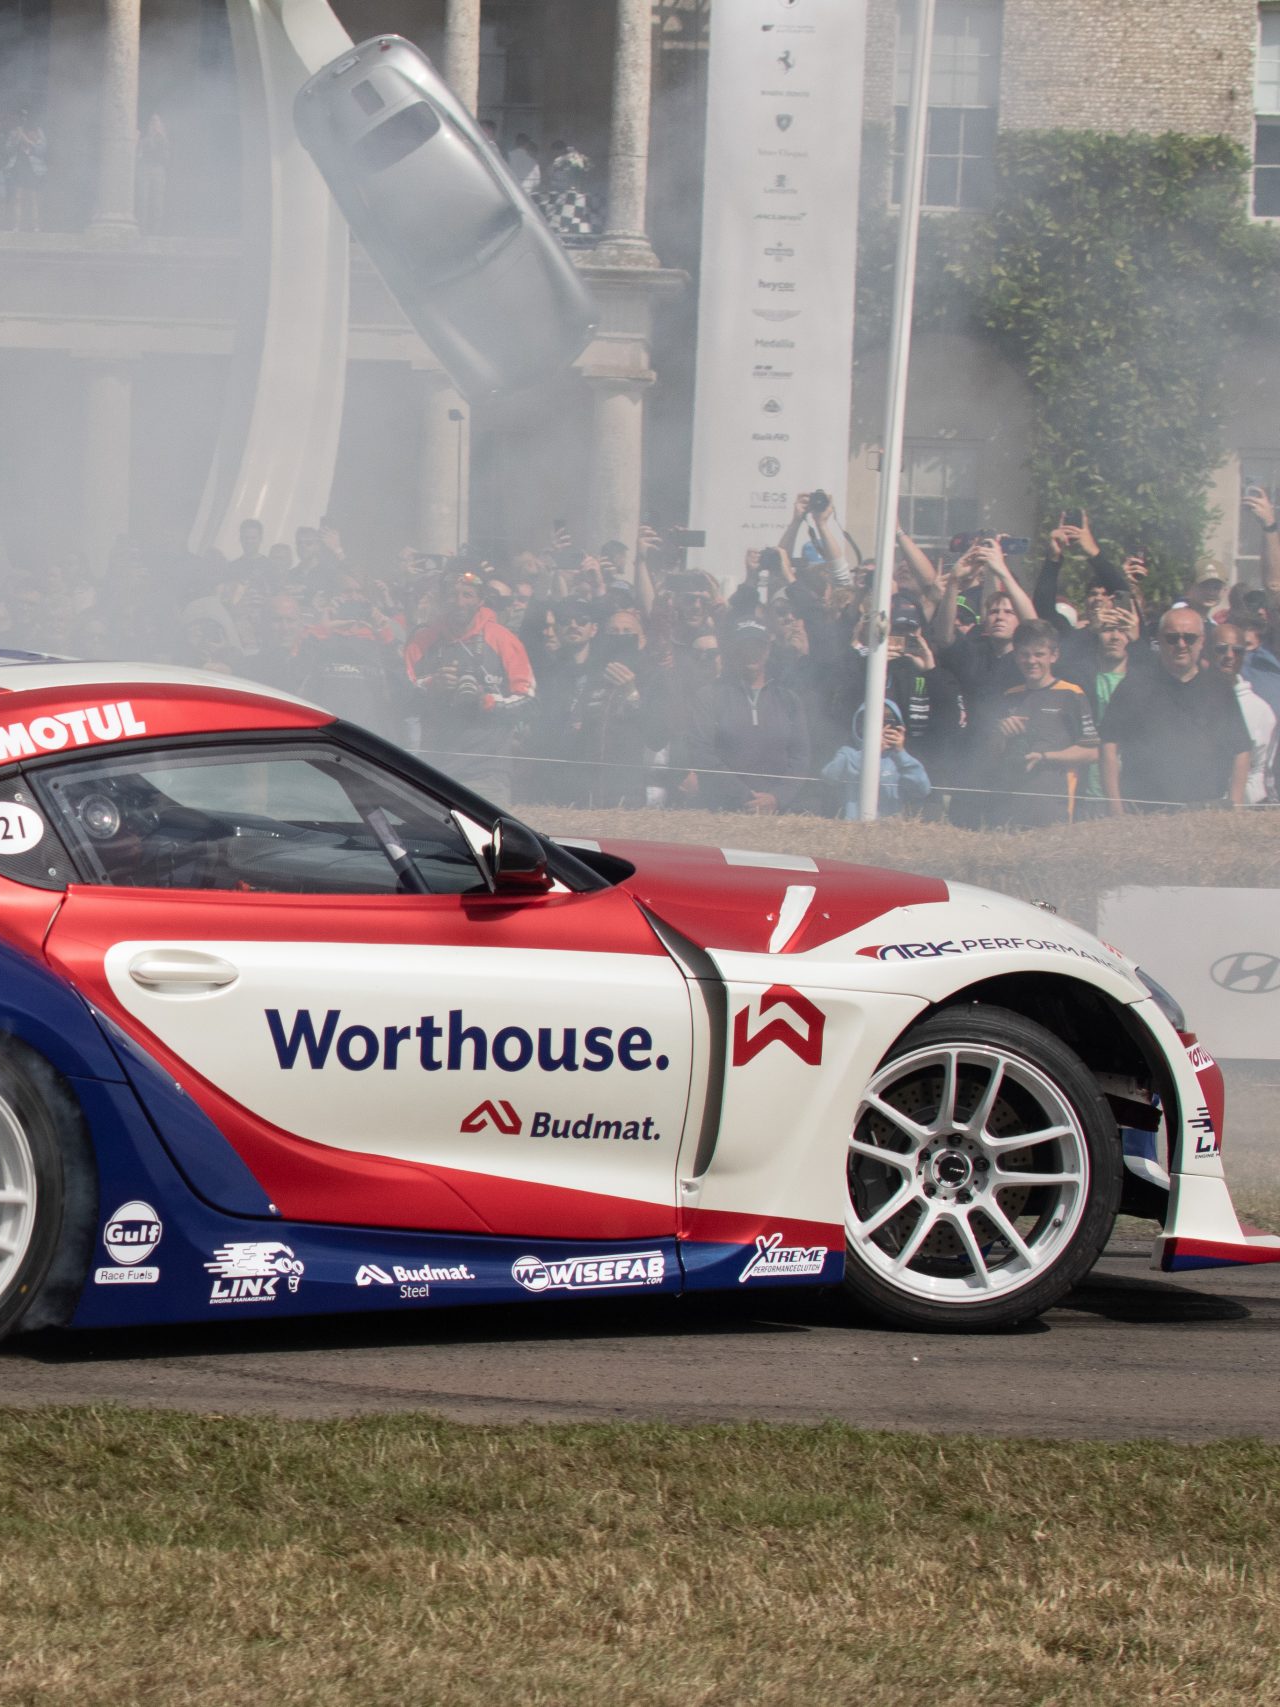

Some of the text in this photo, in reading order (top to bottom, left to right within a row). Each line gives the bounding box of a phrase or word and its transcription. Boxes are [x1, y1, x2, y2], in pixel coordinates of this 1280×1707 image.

[750, 491, 787, 502] INEOS
[879, 941, 963, 961] ARK
[264, 1008, 670, 1073] Worthouse.
[530, 1112, 661, 1141] Budmat.
[106, 1223, 160, 1243] Gulf
[742, 1236, 825, 1280] XTREME
[100, 1269, 153, 1281] Race Fuels
[392, 1263, 476, 1282] Budmat.
[549, 1257, 665, 1284] WISEFAB
[210, 1277, 280, 1298] LINK
[400, 1284, 430, 1299] Steel
[233, 1295, 276, 1303] MANAGEMENT
